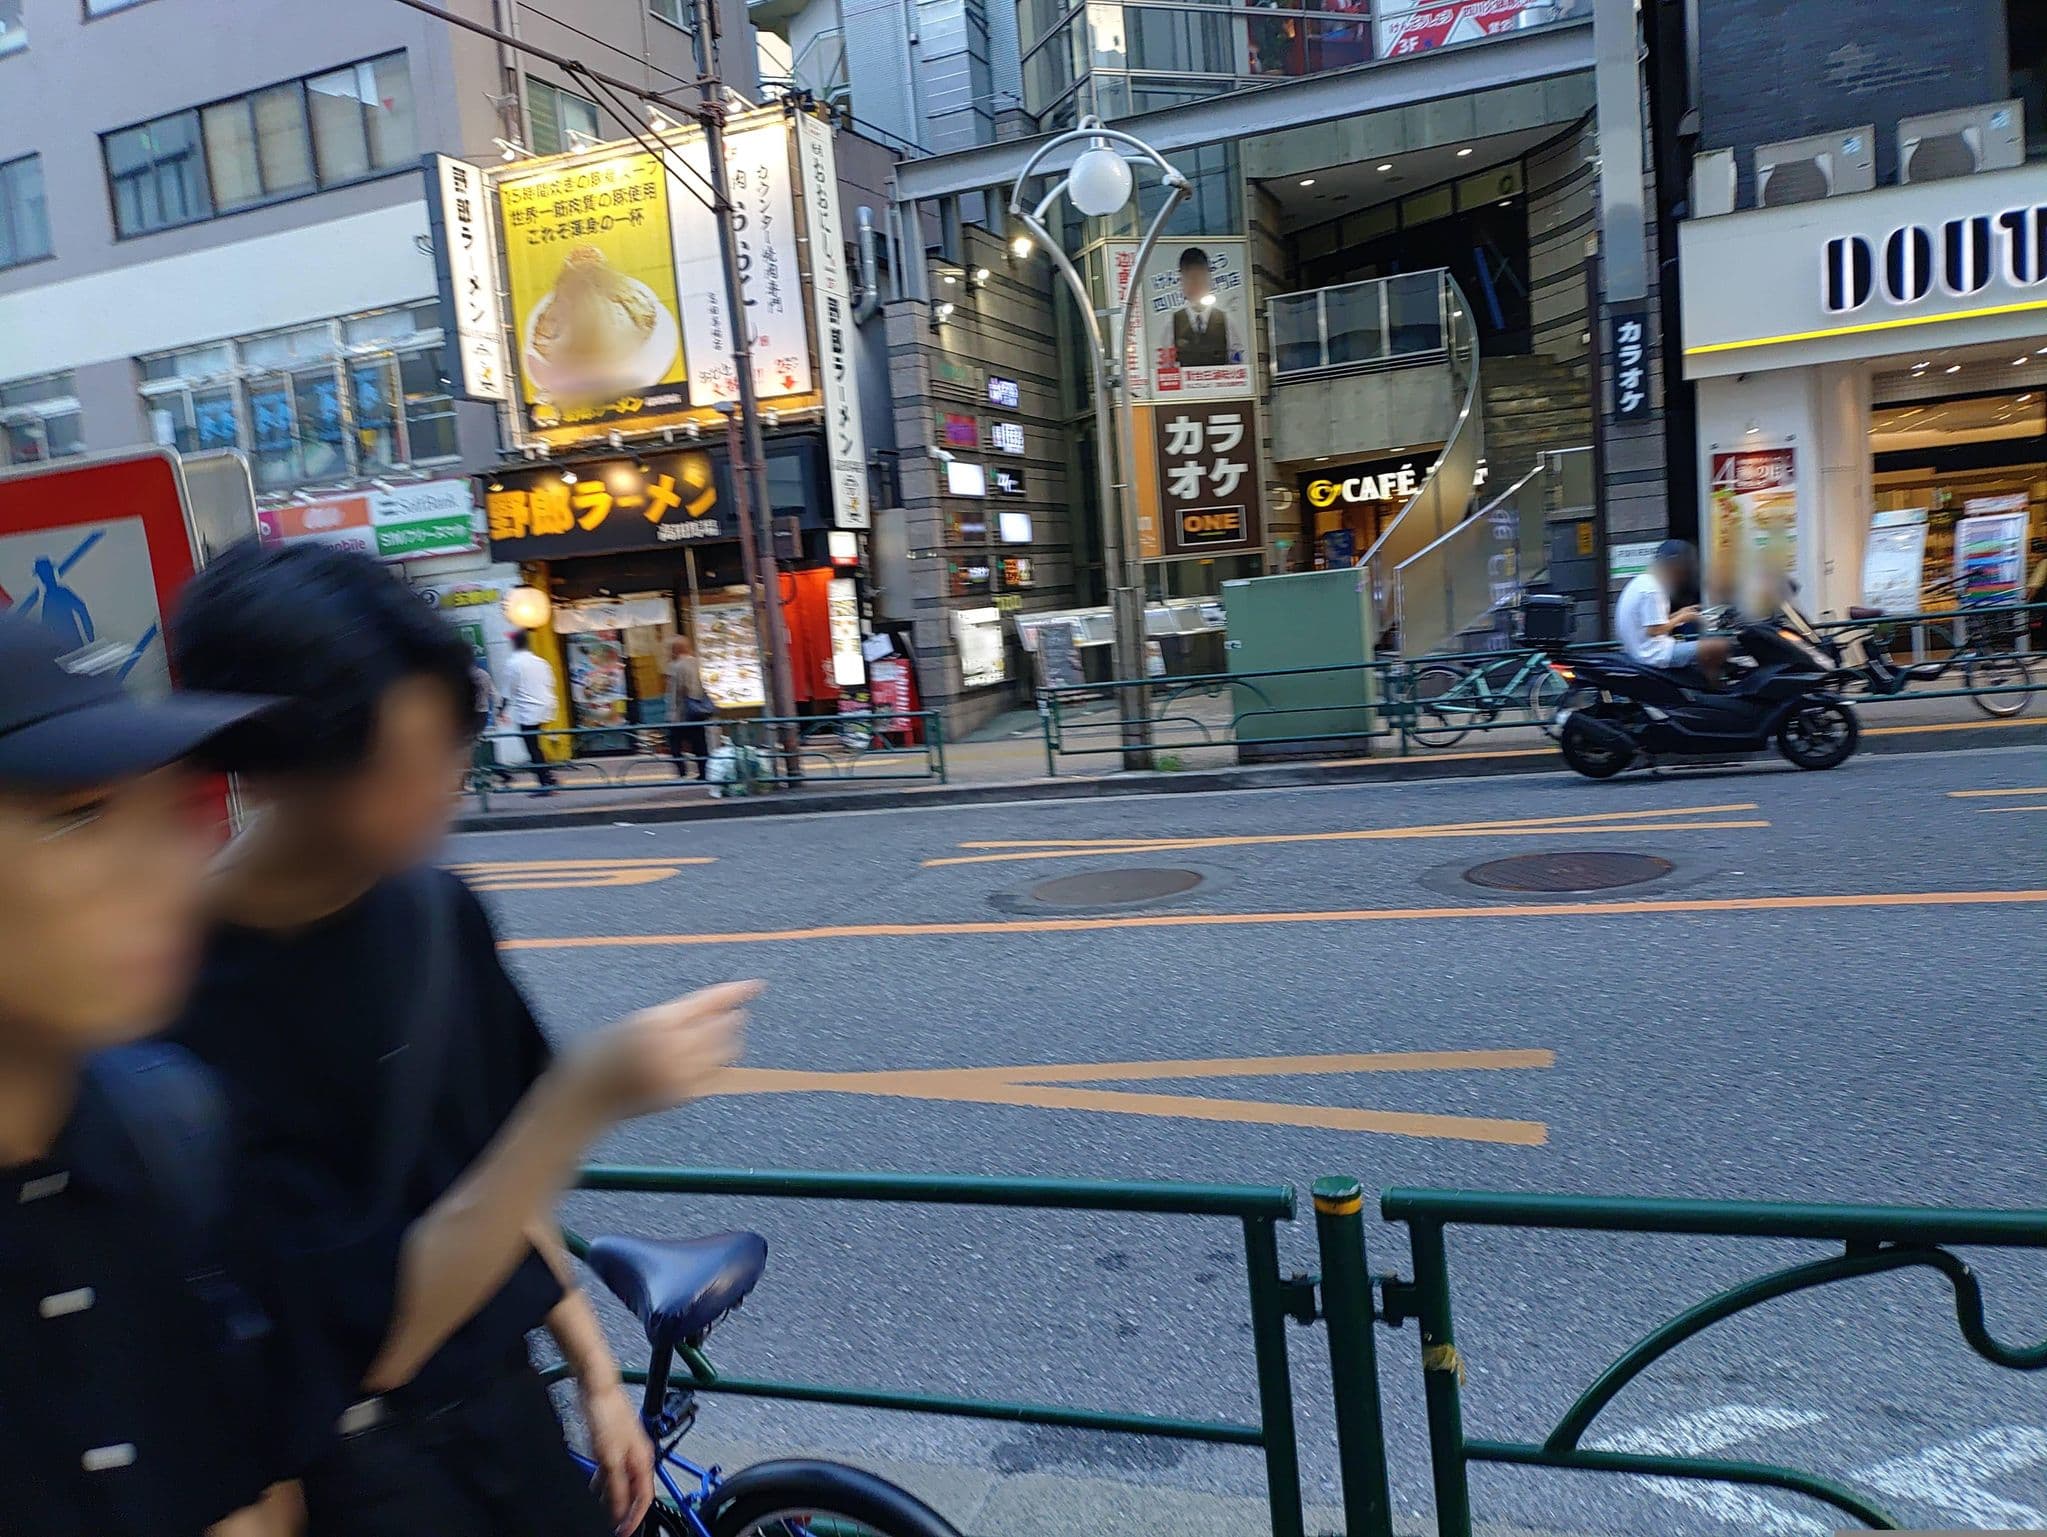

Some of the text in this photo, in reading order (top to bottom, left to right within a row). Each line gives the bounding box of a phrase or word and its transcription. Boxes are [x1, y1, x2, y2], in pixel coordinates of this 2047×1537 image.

[1617, 320, 1645, 413] カラオケ
[486, 457, 718, 541] 野郎ラーメン
[1342, 463, 1421, 503] CAFÉ
[1183, 512, 1240, 533] ONE
